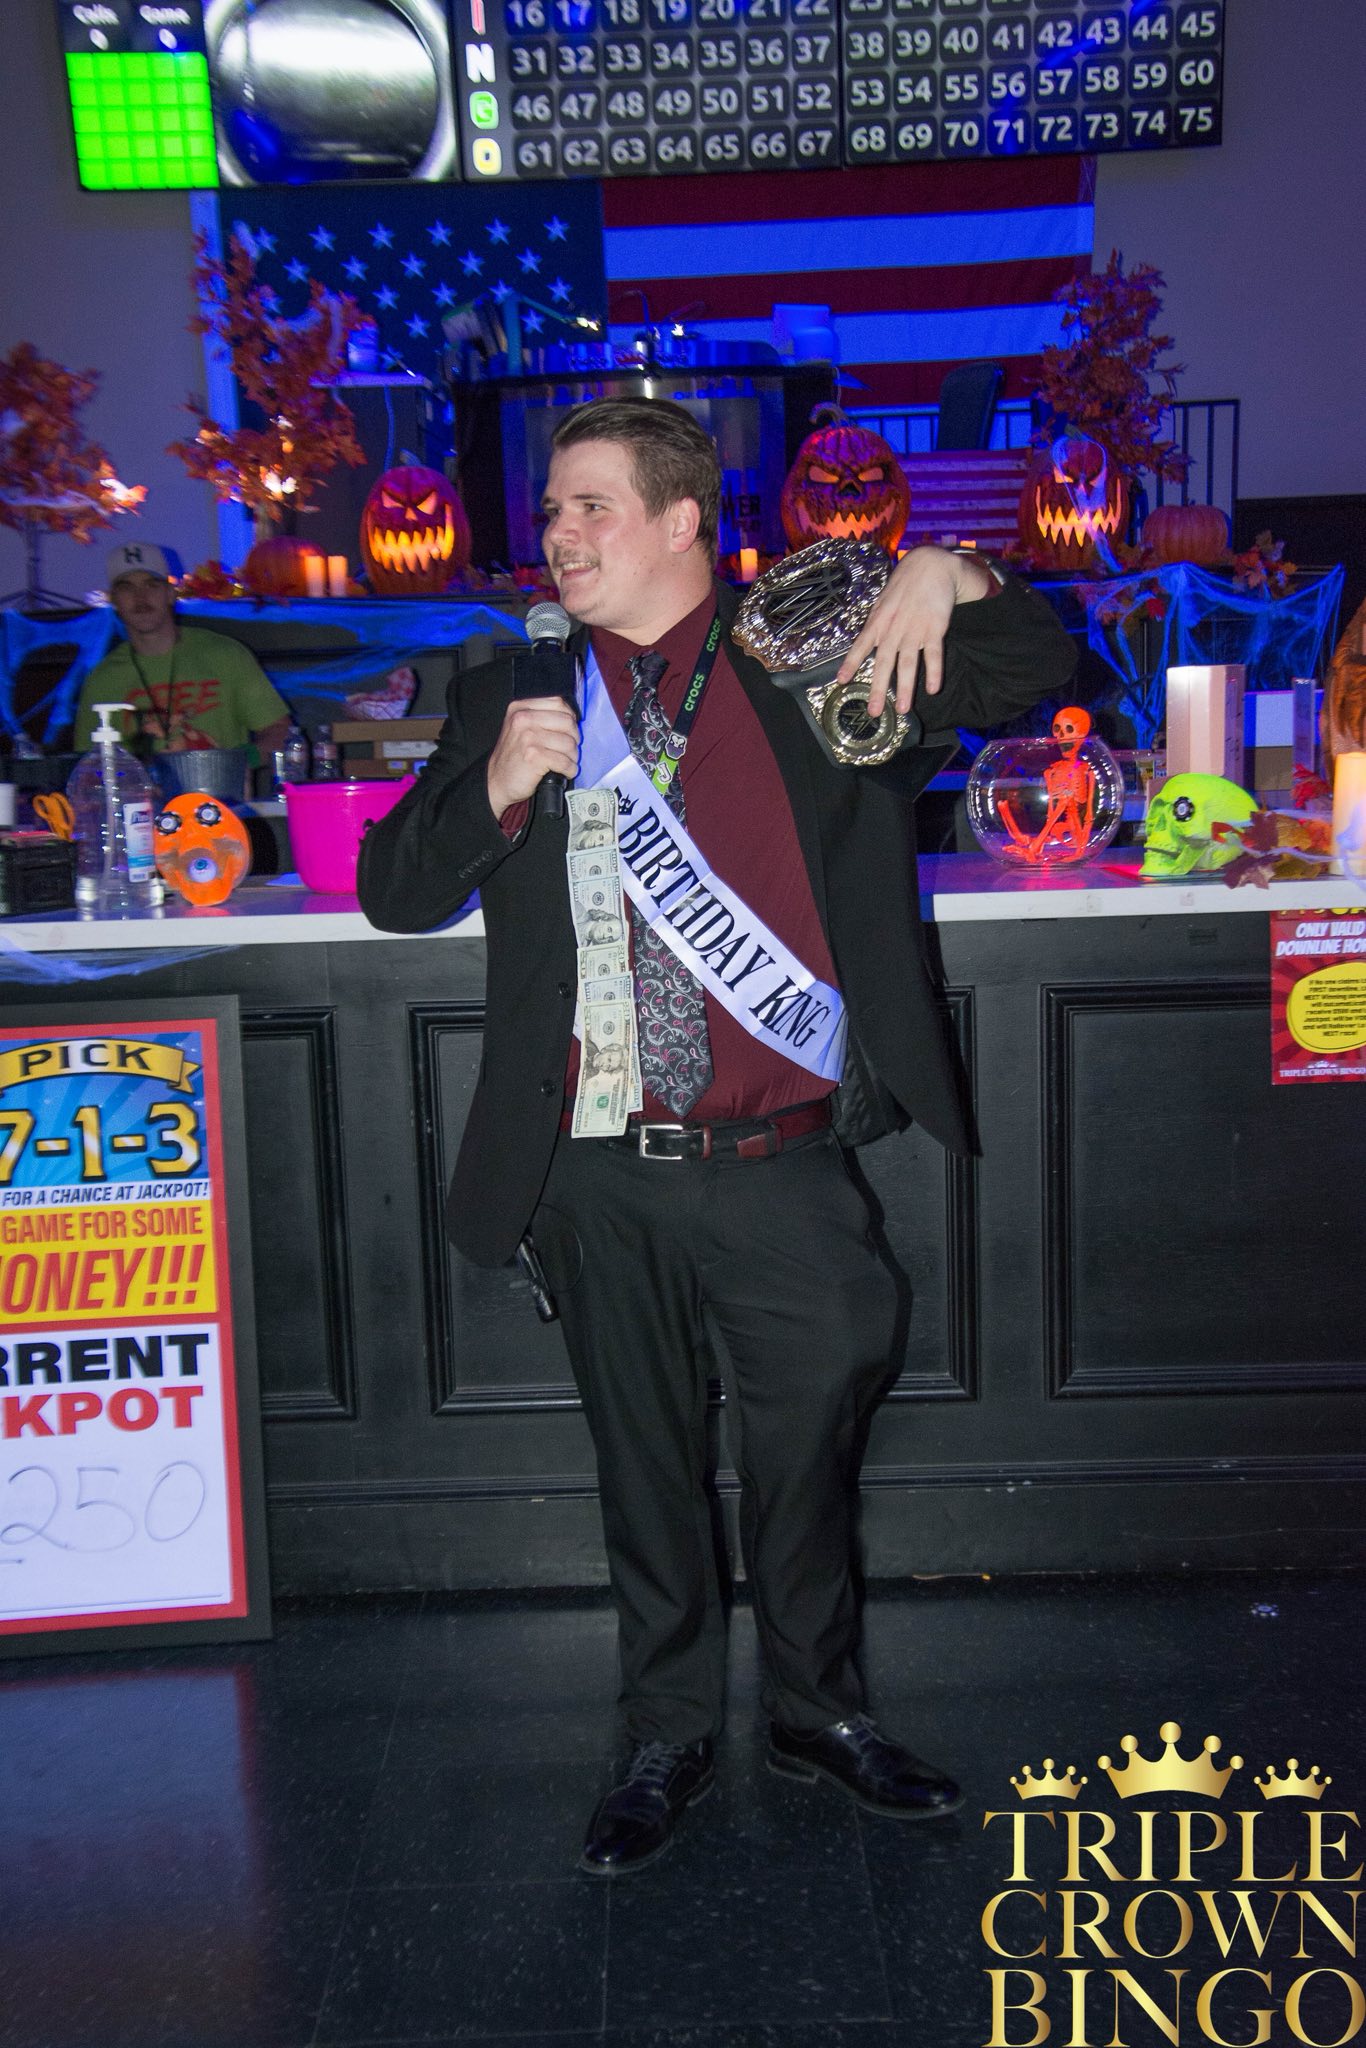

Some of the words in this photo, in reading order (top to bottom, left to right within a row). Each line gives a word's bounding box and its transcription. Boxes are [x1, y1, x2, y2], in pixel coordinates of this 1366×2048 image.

[509, 0, 545, 27] 16
[556, 0, 592, 25] 17
[604, 0, 640, 23] 18
[652, 0, 687, 22] 19
[465, 43, 497, 83] N
[514, 47, 547, 75] 31
[558, 45, 596, 74] 32
[606, 44, 643, 72] 33
[654, 42, 690, 70] 34
[701, 40, 737, 68] 35
[748, 38, 785, 66] 36
[795, 36, 831, 64] 37
[849, 31, 885, 59] 38
[896, 29, 932, 57] 39
[943, 26, 979, 54] 40
[992, 24, 1025, 51] 41
[1037, 20, 1073, 48] 42
[1085, 17, 1121, 44] 43
[1132, 14, 1169, 41] 44
[1180, 11, 1216, 38] 45
[469, 90, 499, 129] G
[514, 95, 551, 121] 46
[561, 93, 597, 120] 47
[608, 91, 645, 118] 48
[655, 89, 692, 116] 49
[703, 87, 738, 115] 50
[752, 86, 784, 113] 51
[797, 83, 832, 110] 52
[851, 79, 885, 106] 53
[897, 76, 933, 104] 54
[944, 74, 979, 101] 55
[990, 71, 1026, 99] 56
[1038, 68, 1073, 96] 57
[1085, 65, 1120, 93] 58
[1132, 62, 1167, 90] 59
[1179, 59, 1215, 86] 60
[519, 141, 552, 167] 61
[564, 139, 600, 166] 62
[611, 137, 646, 164] 63
[657, 136, 693, 162] 64
[705, 134, 740, 160] 65
[751, 132, 787, 158] 66
[798, 130, 833, 156] 67
[851, 125, 886, 152] 68
[898, 123, 933, 150] 69
[944, 121, 979, 147] 70
[993, 118, 1025, 145] 71
[1038, 115, 1073, 142] 72
[1085, 112, 1119, 139] 73
[1131, 110, 1166, 136] 74
[1179, 106, 1213, 133] 75
[124, 547, 143, 564] H
[684, 673, 705, 712] crocs
[618, 806, 776, 993] BIRTHDAY
[748, 975, 831, 1049] KING
[1296, 922, 1329, 938] ONLY
[1275, 939, 1343, 956] DOWNLINE
[19, 1044, 153, 1077] PICK
[0, 1102, 202, 1186] 7-1-3
[2, 1190, 33, 1207] FOR
[34, 1189, 47, 1205] A
[51, 1186, 112, 1203] CHANCE
[114, 1185, 133, 1201] AT
[135, 1181, 209, 1200] JACKPOT!
[1, 1212, 75, 1245] GAME
[80, 1209, 127, 1240] FOR
[131, 1206, 204, 1237] SOME
[0, 1244, 206, 1315] ONEY!!!
[0, 1333, 210, 1387] RENT
